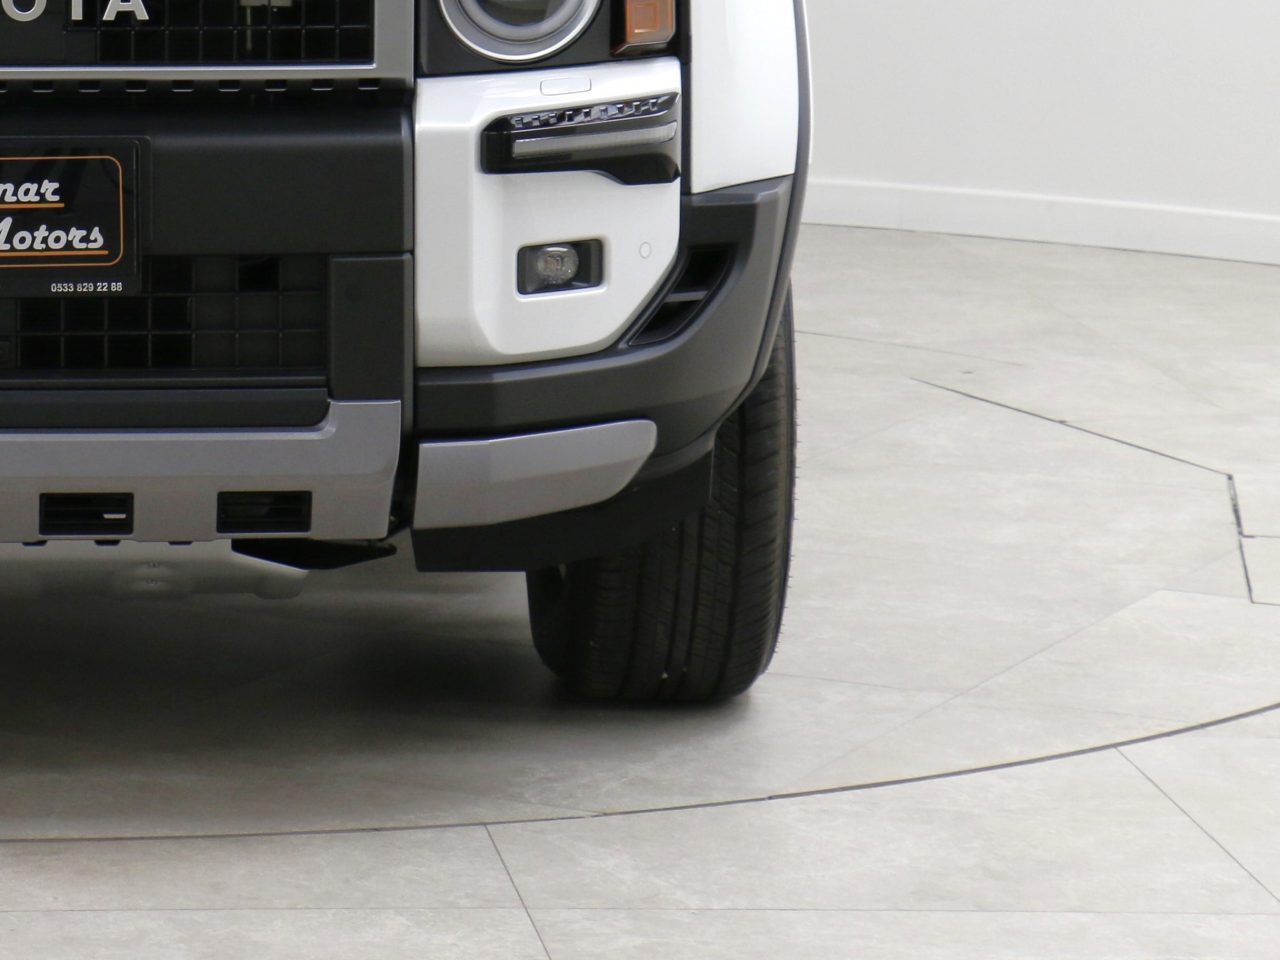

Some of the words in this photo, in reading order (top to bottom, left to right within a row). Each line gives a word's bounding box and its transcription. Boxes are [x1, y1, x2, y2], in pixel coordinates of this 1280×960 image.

[50, 282, 74, 292] 0533
[76, 282, 94, 292] 829
[96, 282, 109, 292] 22
